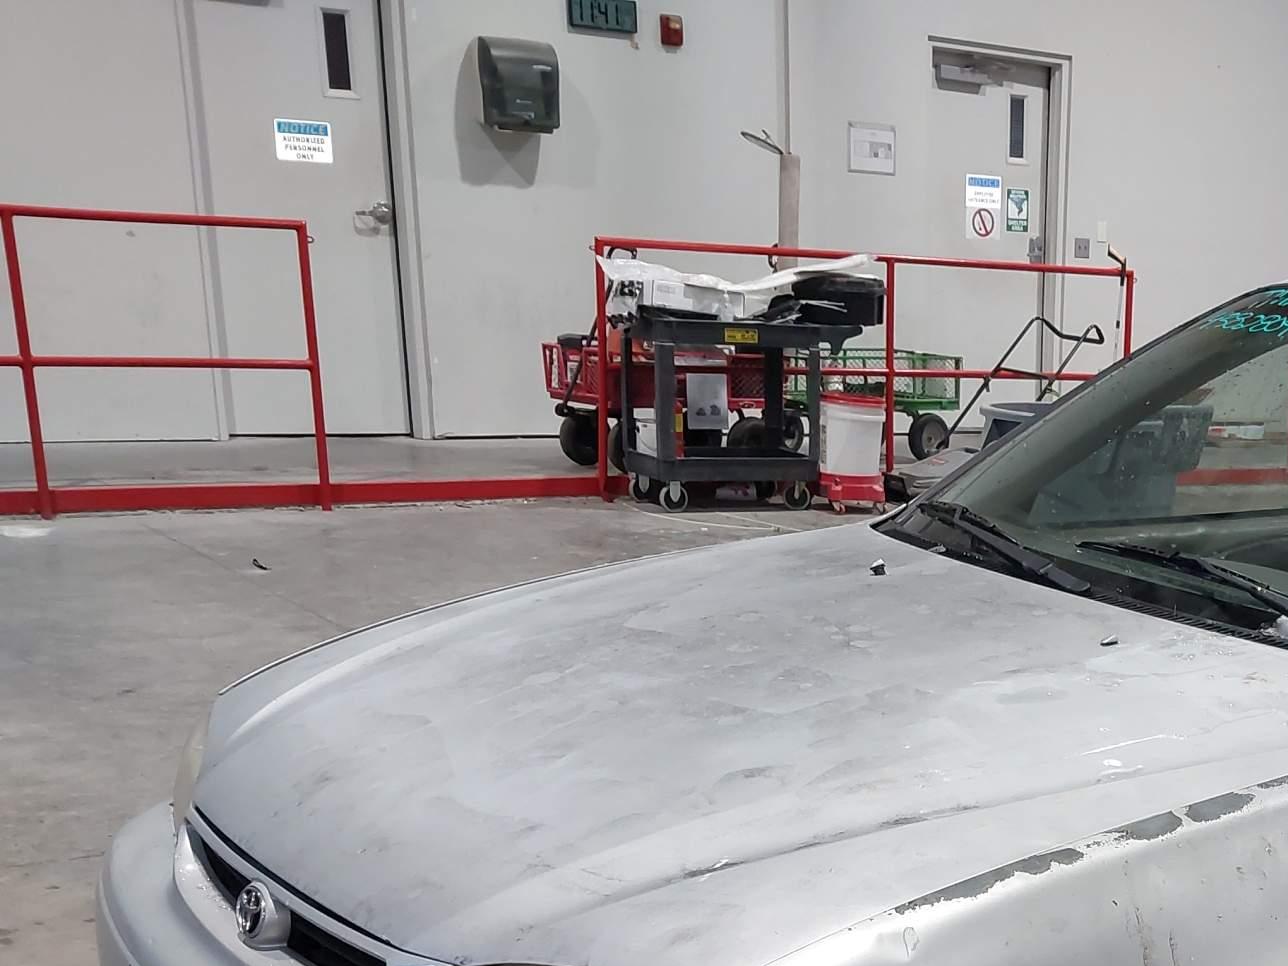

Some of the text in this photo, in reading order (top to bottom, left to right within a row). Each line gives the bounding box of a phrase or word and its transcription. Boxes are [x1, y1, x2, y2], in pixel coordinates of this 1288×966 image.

[279, 121, 328, 136] NOTICE
[283, 135, 325, 145] AUTHORIZED
[285, 144, 325, 153] PERSONNEL
[296, 152, 314, 160] ONLY
